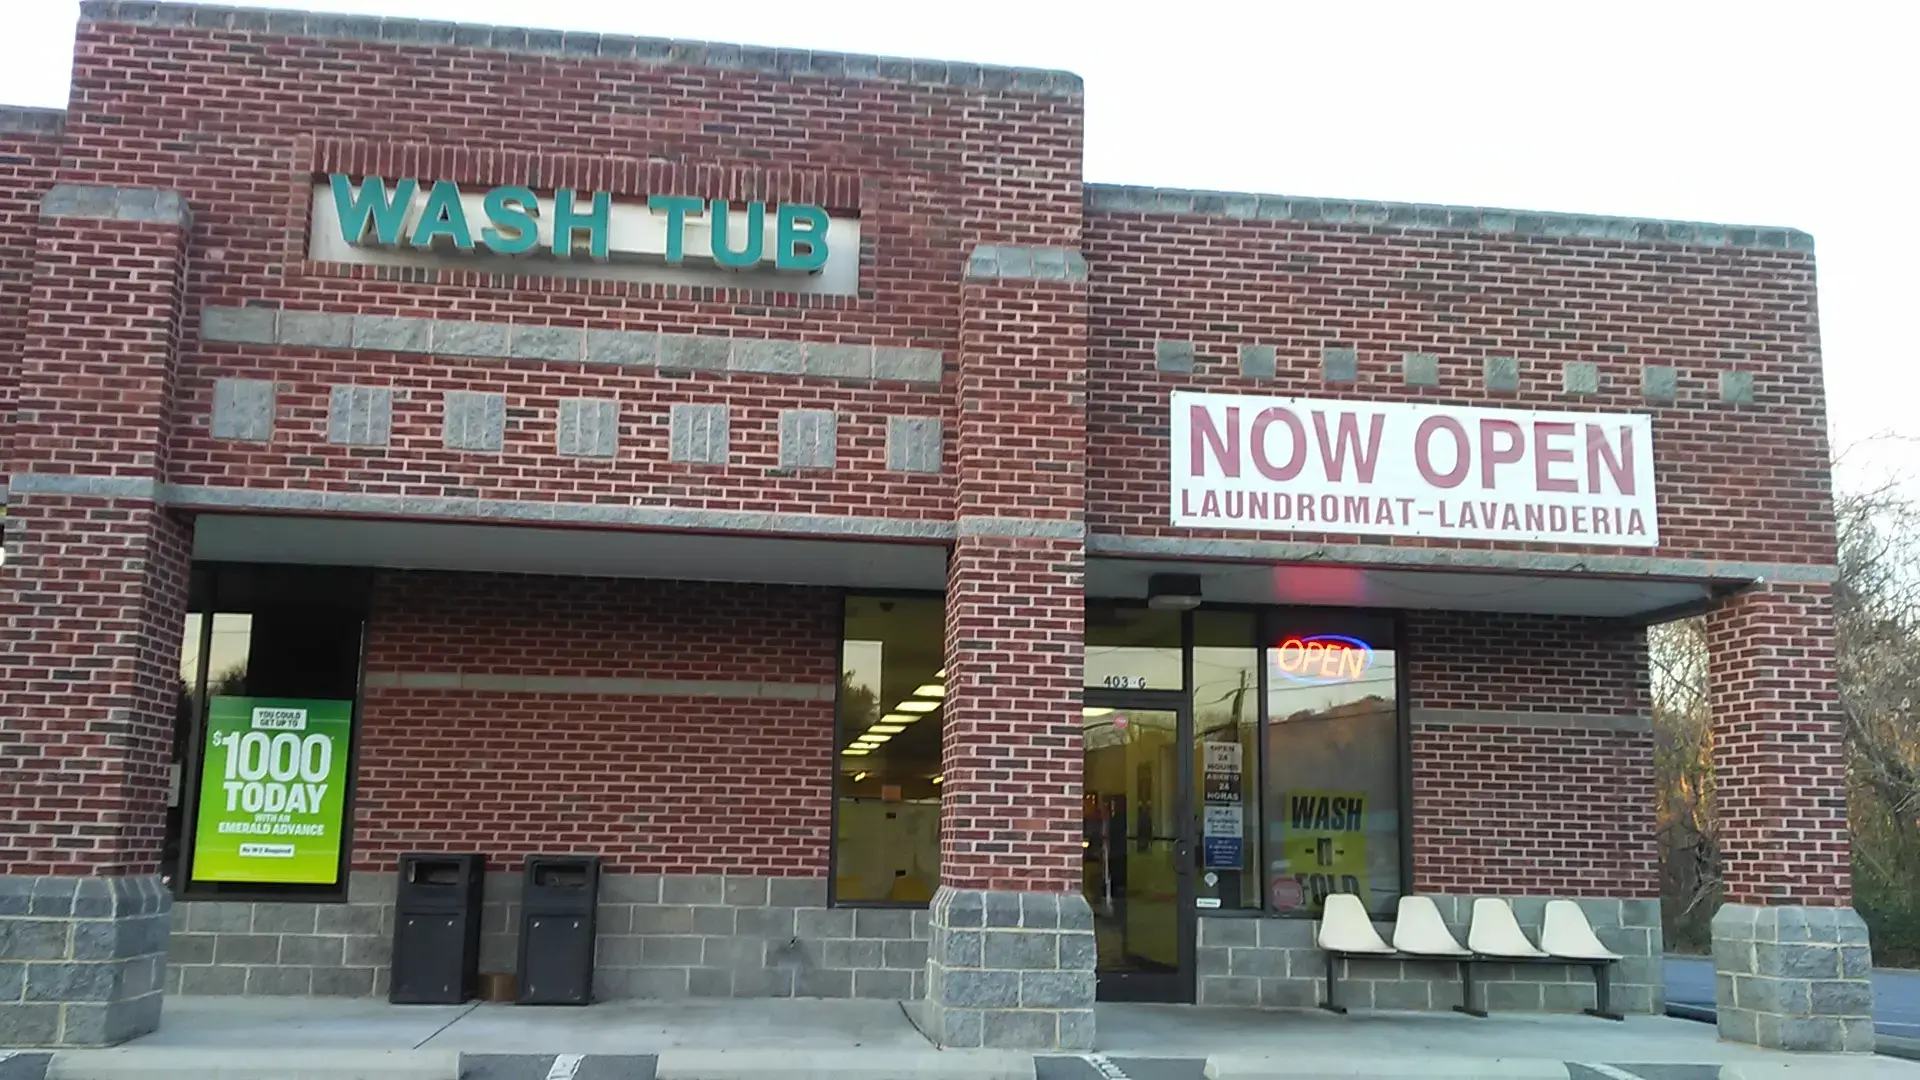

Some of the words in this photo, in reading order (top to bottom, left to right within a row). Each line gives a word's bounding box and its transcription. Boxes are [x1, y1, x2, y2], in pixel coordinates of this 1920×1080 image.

[330, 173, 612, 257] WASH
[648, 195, 830, 271] TUB
[1189, 404, 1386, 484] NOW
[1414, 414, 1637, 496] OPEN
[1278, 638, 1365, 680] OPEN
[259, 711, 274, 719] YOU
[275, 711, 301, 720] COULD
[260, 719, 275, 727] GET
[287, 720, 298, 728] TO
[1218, 782, 1230, 791] 24
[223, 781, 328, 814] TODAY
[1207, 791, 1240, 800] HORAS
[254, 813, 277, 823] WITH
[277, 814, 291, 823] AN
[1292, 796, 1364, 831] WASH
[218, 822, 271, 835] EMERALD
[271, 823, 325, 836] ADVANCE
